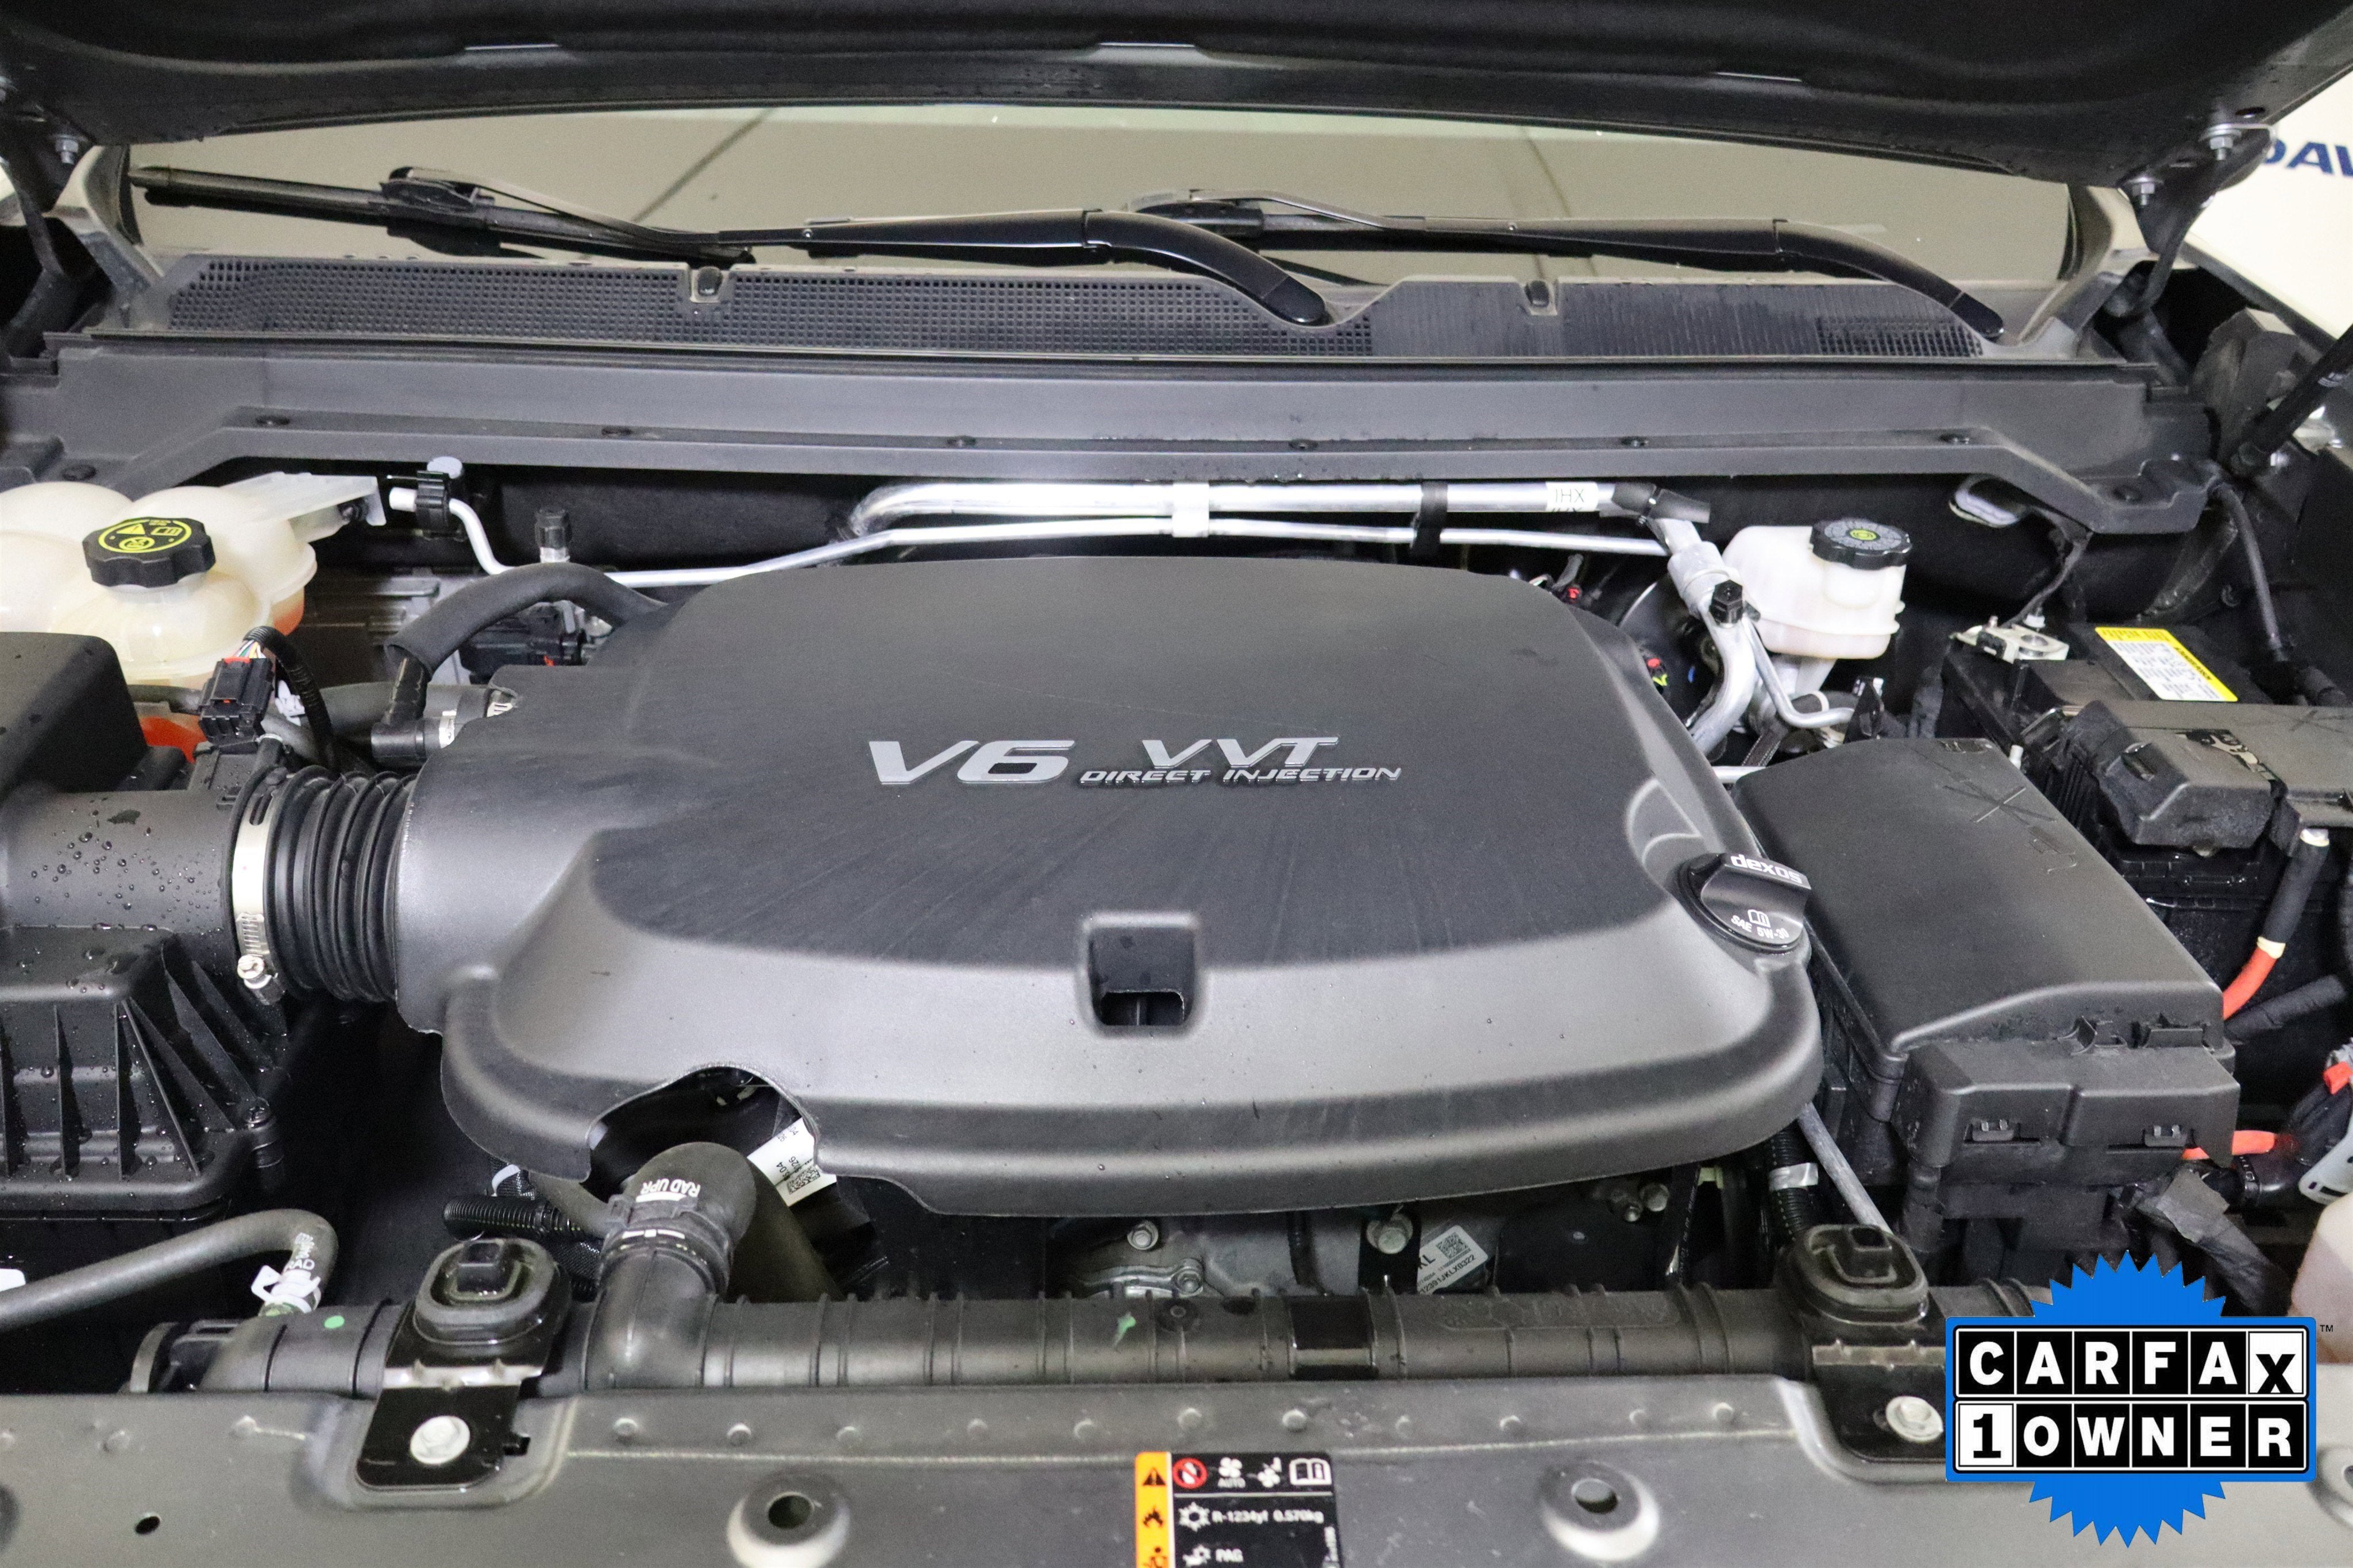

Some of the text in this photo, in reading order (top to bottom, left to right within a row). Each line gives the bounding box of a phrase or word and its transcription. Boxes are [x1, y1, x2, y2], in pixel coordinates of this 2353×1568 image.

[869, 736, 1339, 785] V6 VVT
[1078, 767, 1402, 785] DIRECT INJECTION
[1730, 853, 1803, 885] dexos
[1731, 914, 1789, 940] SAE 5W-30
[640, 1178, 701, 1198] RAD UPR
[1215, 1548, 1244, 1563] PAG
